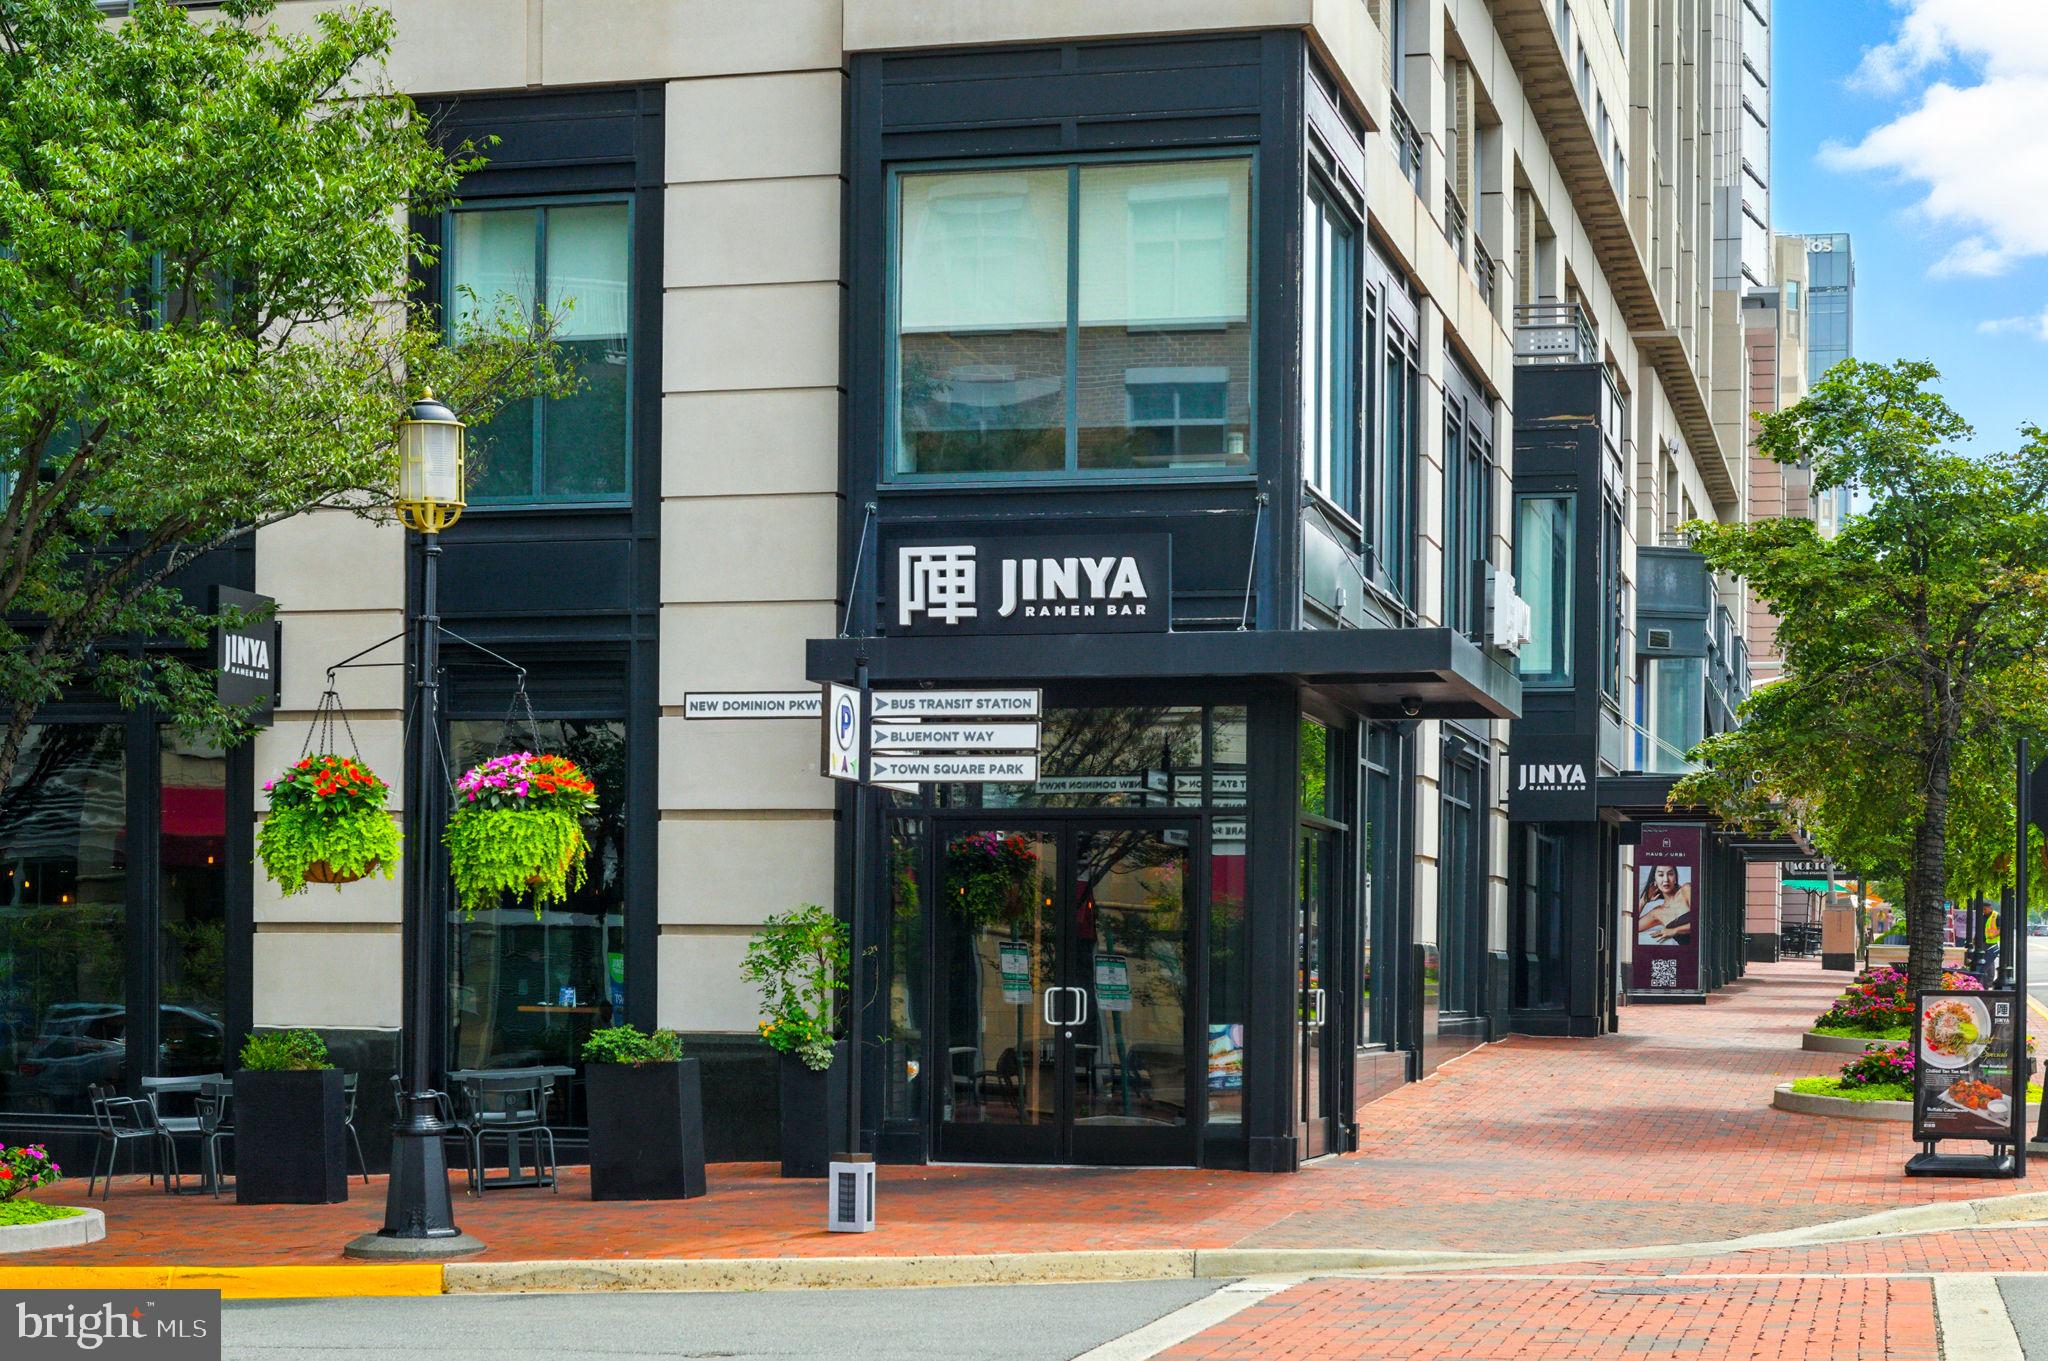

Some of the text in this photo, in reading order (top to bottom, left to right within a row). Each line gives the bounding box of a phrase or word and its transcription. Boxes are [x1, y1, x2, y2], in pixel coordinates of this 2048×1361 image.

[998, 557, 1147, 617] JINYA
[1025, 605, 1146, 616] RAMEN BAR
[224, 634, 269, 672] JINYA
[231, 666, 254, 677] RAMEN
[690, 701, 718, 711] NEW
[722, 700, 785, 711] DOMINION
[891, 699, 1031, 709] BUS TRANSIT STATION
[841, 705, 851, 739] P
[891, 732, 994, 742] BLUEMONT WAY
[890, 764, 1023, 775] TOWN SQUARE PARK
[1518, 765, 1587, 790] JINYA
